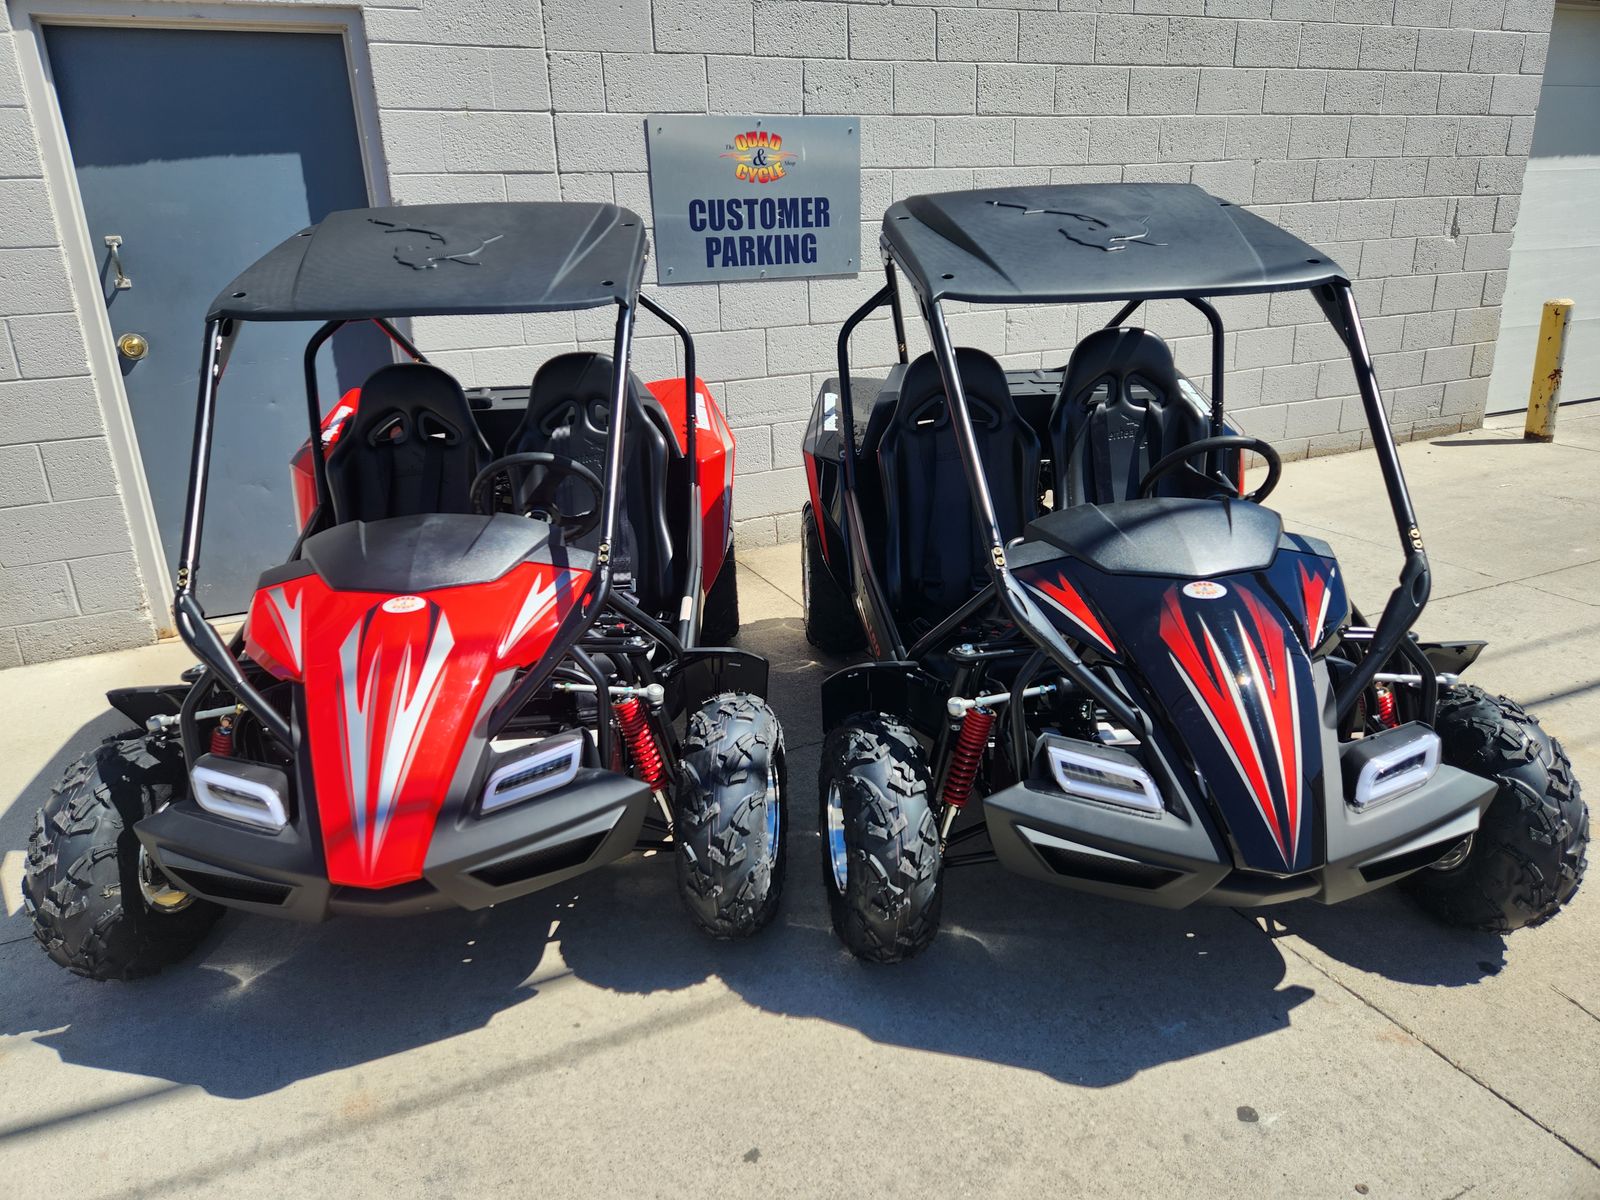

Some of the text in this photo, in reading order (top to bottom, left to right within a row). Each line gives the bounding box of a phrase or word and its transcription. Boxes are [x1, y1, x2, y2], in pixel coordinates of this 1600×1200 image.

[735, 131, 782, 151] QUAD
[753, 148, 767, 166] &
[735, 161, 787, 183] CYCLE
[689, 196, 830, 232] CUSTOMER
[705, 233, 817, 268] PARKING
